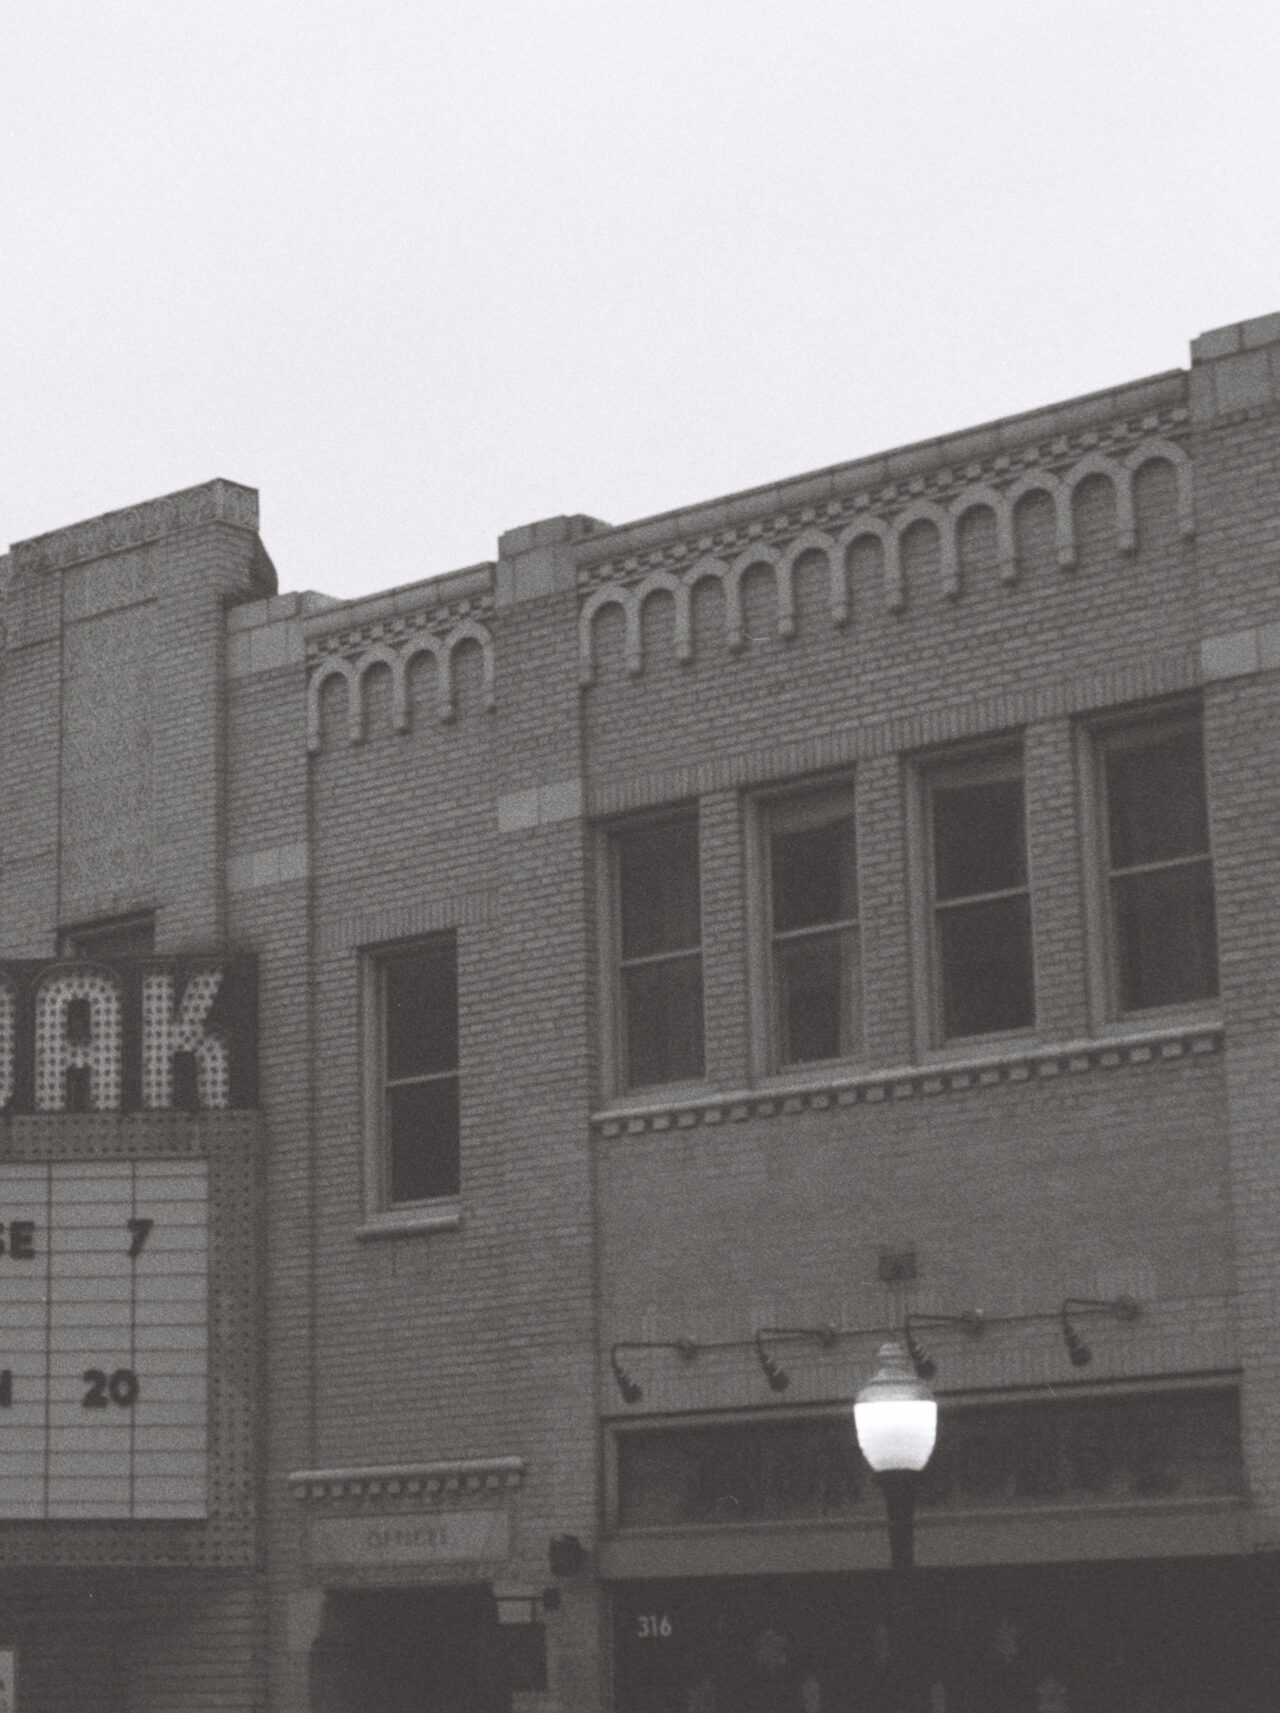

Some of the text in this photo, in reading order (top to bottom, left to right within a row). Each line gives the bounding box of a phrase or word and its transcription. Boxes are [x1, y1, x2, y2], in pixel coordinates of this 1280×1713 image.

[126, 1217, 154, 1257] 7
[82, 1368, 140, 1408] 20
[636, 1615, 673, 1639] 316
